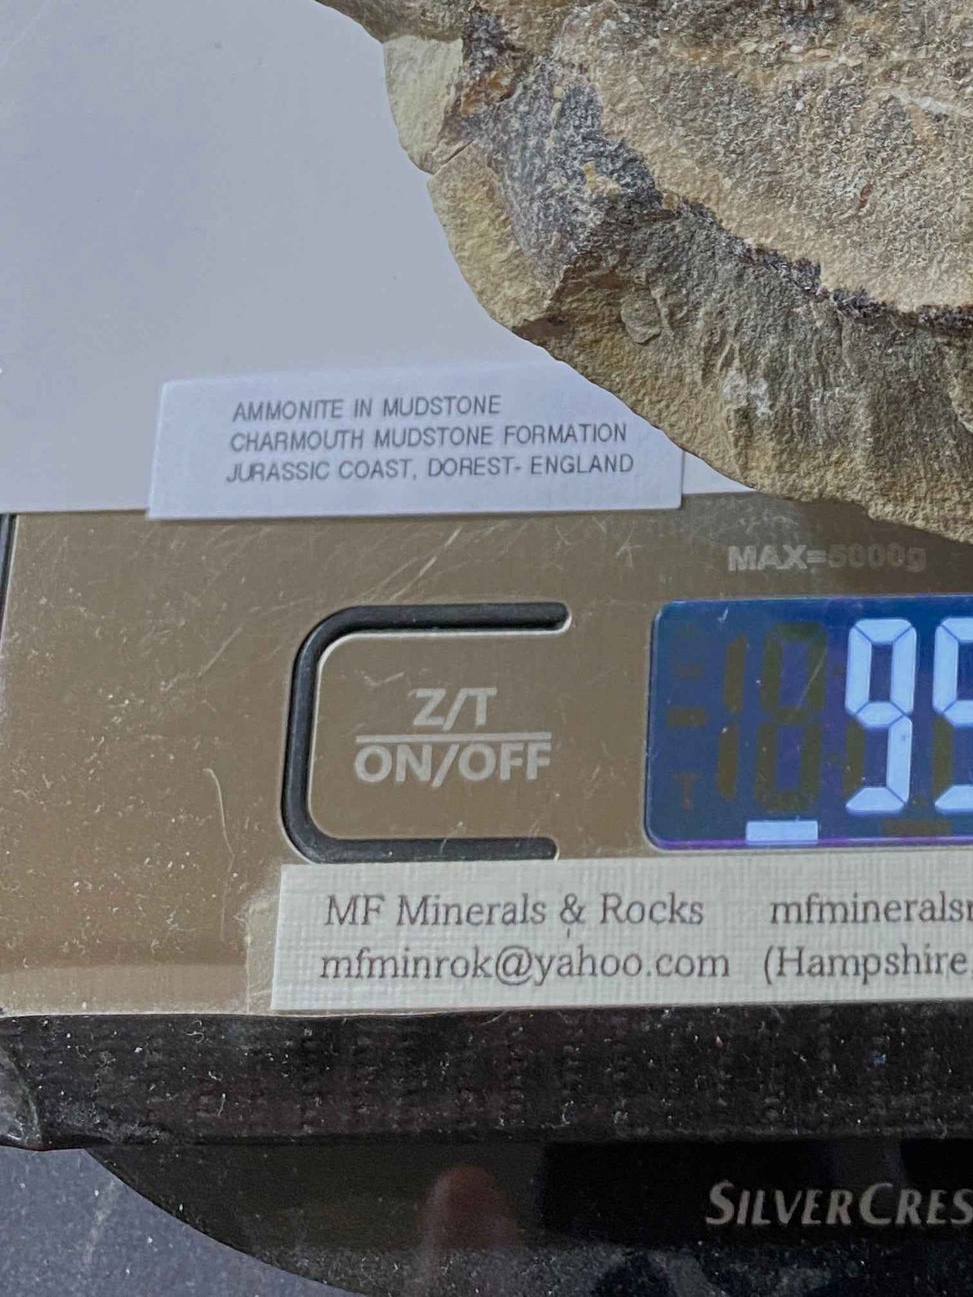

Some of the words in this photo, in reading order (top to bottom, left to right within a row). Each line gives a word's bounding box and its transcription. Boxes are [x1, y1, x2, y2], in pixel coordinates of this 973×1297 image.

[232, 399, 345, 422] AMMONITE
[354, 398, 374, 418] IN
[383, 395, 502, 417] MUDSTONE
[230, 430, 364, 452] CHARMOUTH
[375, 427, 493, 448] MUDSTONE
[505, 423, 627, 444] FORMATION
[226, 461, 330, 482] JURASSIC
[339, 459, 417, 481] COAST,
[531, 452, 634, 474] ENGLAND
[410, 687, 497, 731] Z/T
[354, 742, 552, 788] ON/OFF
[325, 895, 385, 927] MF
[395, 894, 546, 926] Minerals
[559, 893, 586, 925] &
[599, 892, 704, 926] Rocks
[319, 945, 730, 986] mfminrok@yahoo.com
